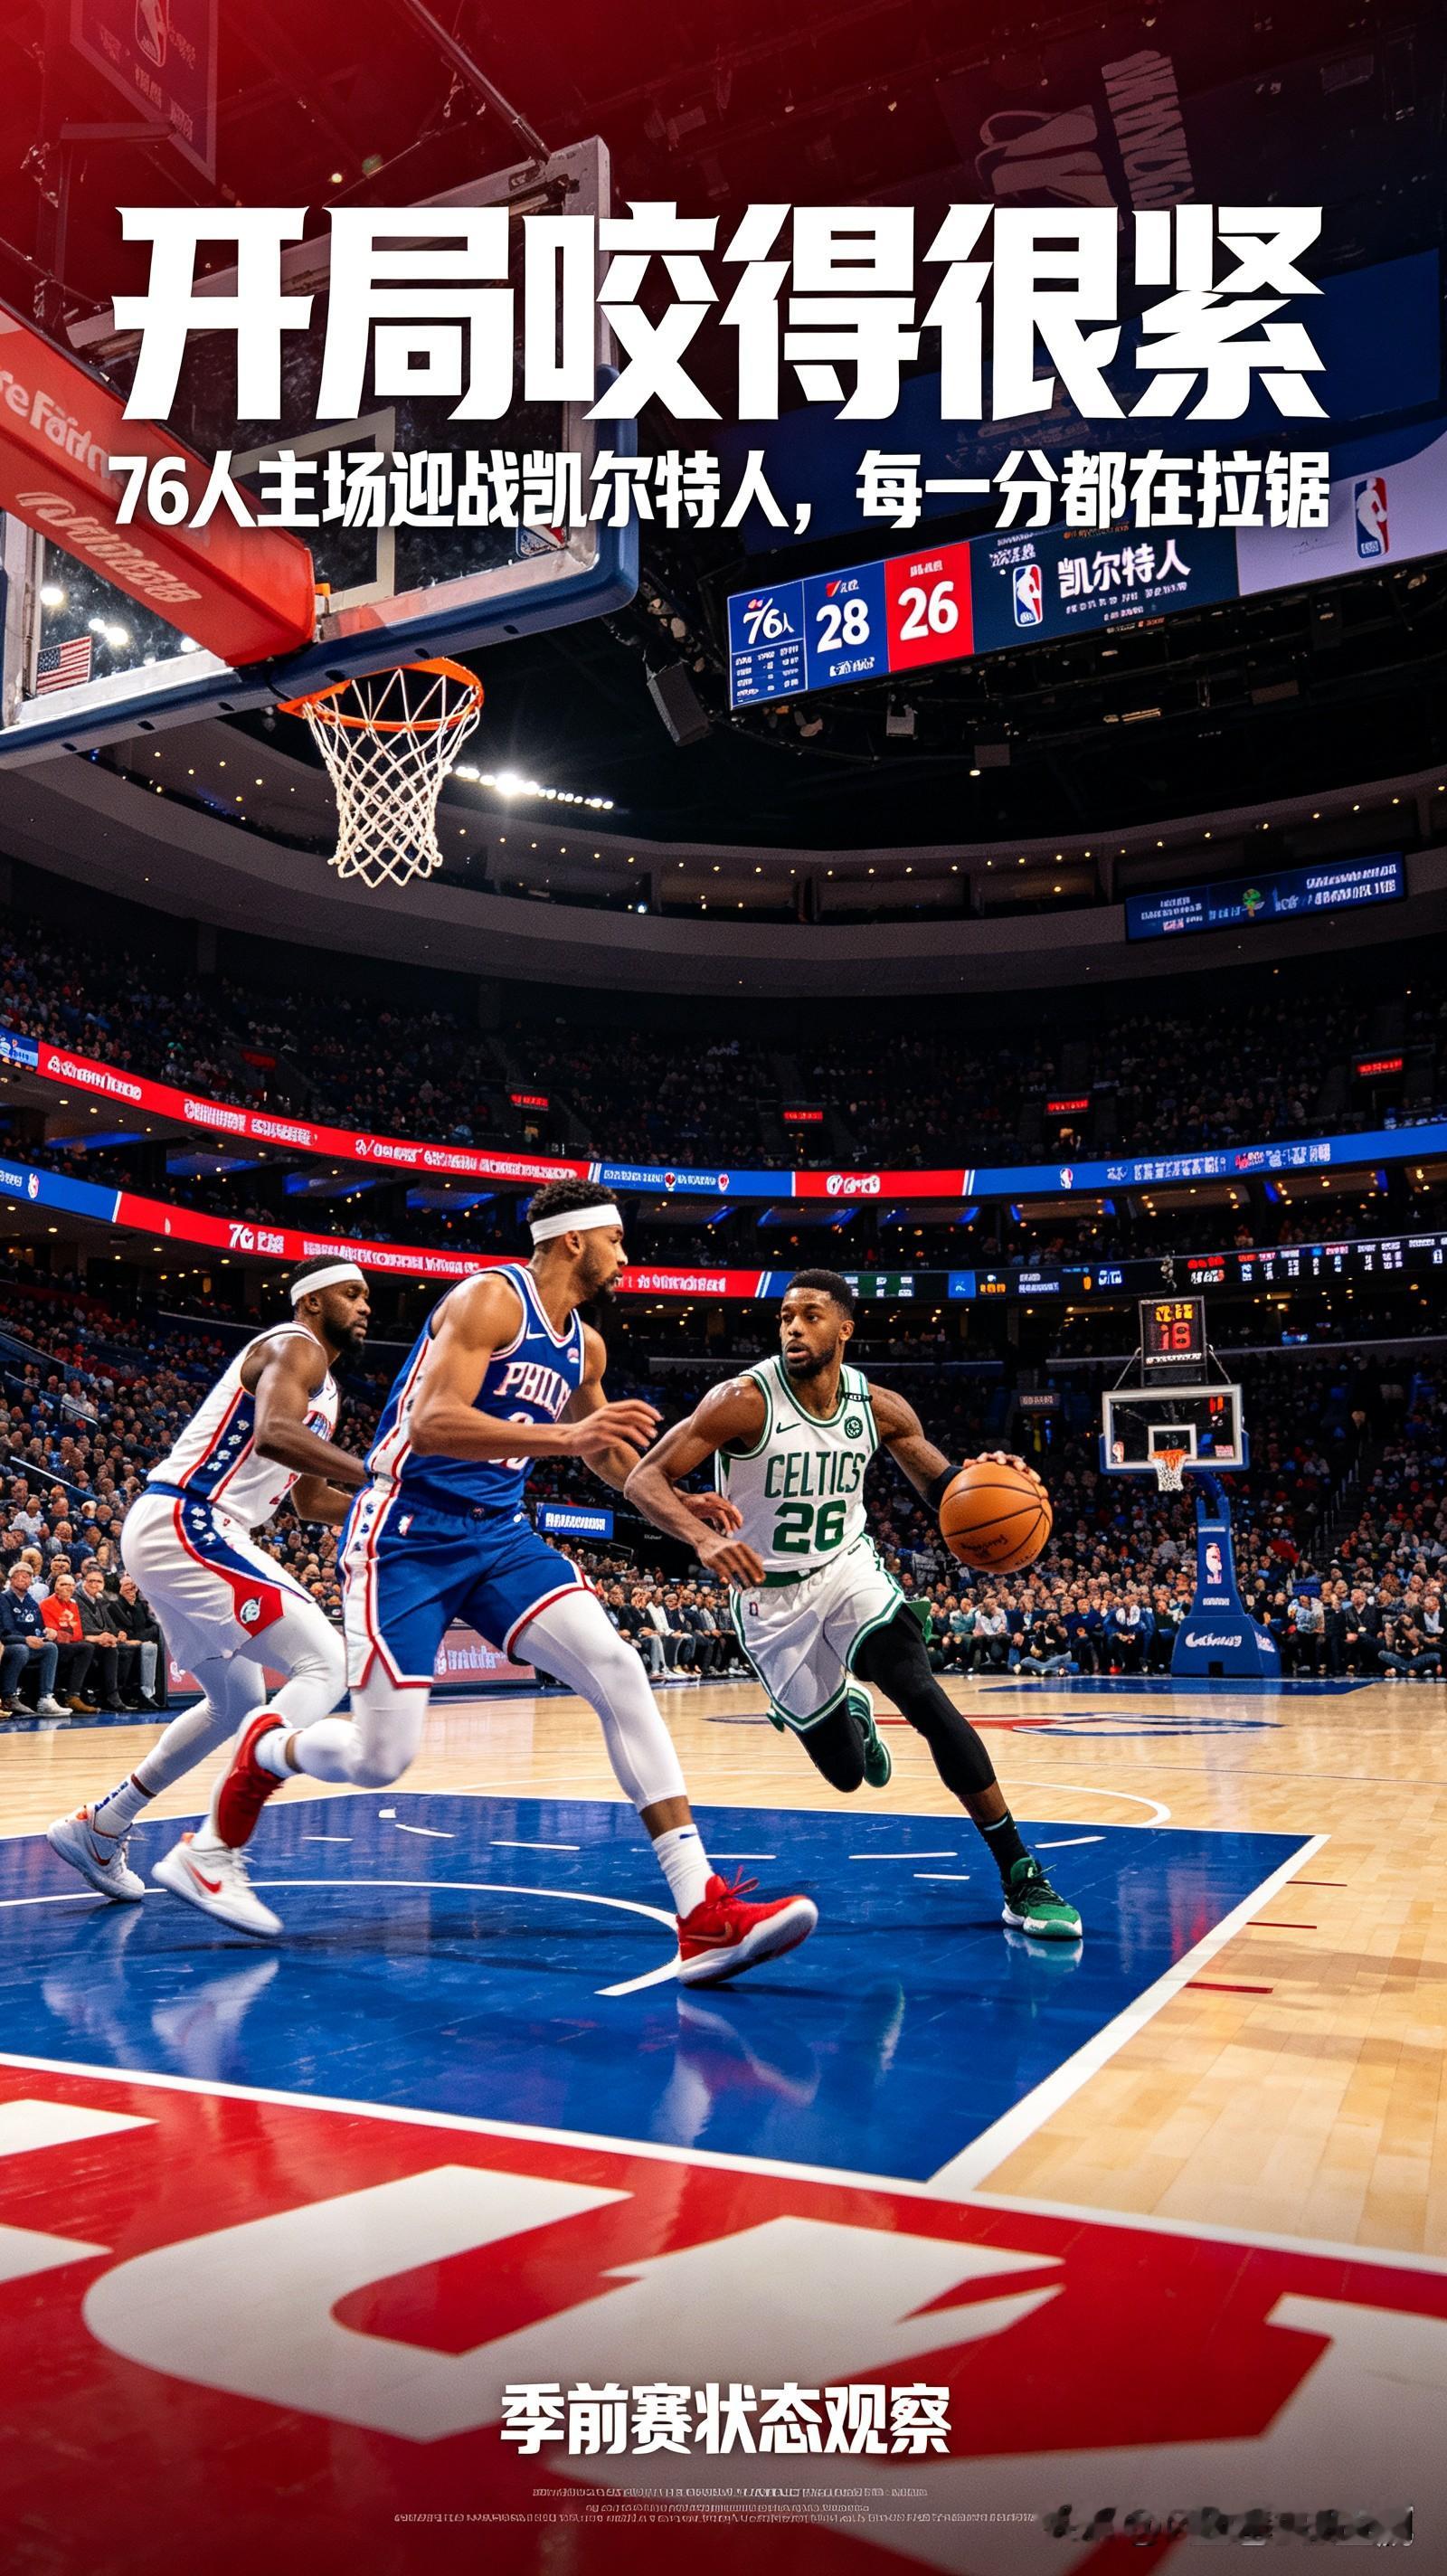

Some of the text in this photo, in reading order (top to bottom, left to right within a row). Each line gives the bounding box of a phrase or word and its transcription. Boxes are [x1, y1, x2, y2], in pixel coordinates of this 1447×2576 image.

[1057, 539, 1192, 599] 凯尔特人
[816, 599, 870, 653] 28
[897, 581, 960, 641] 26
[764, 1451, 866, 1499] CELTICS
[772, 1500, 846, 1554] 26
